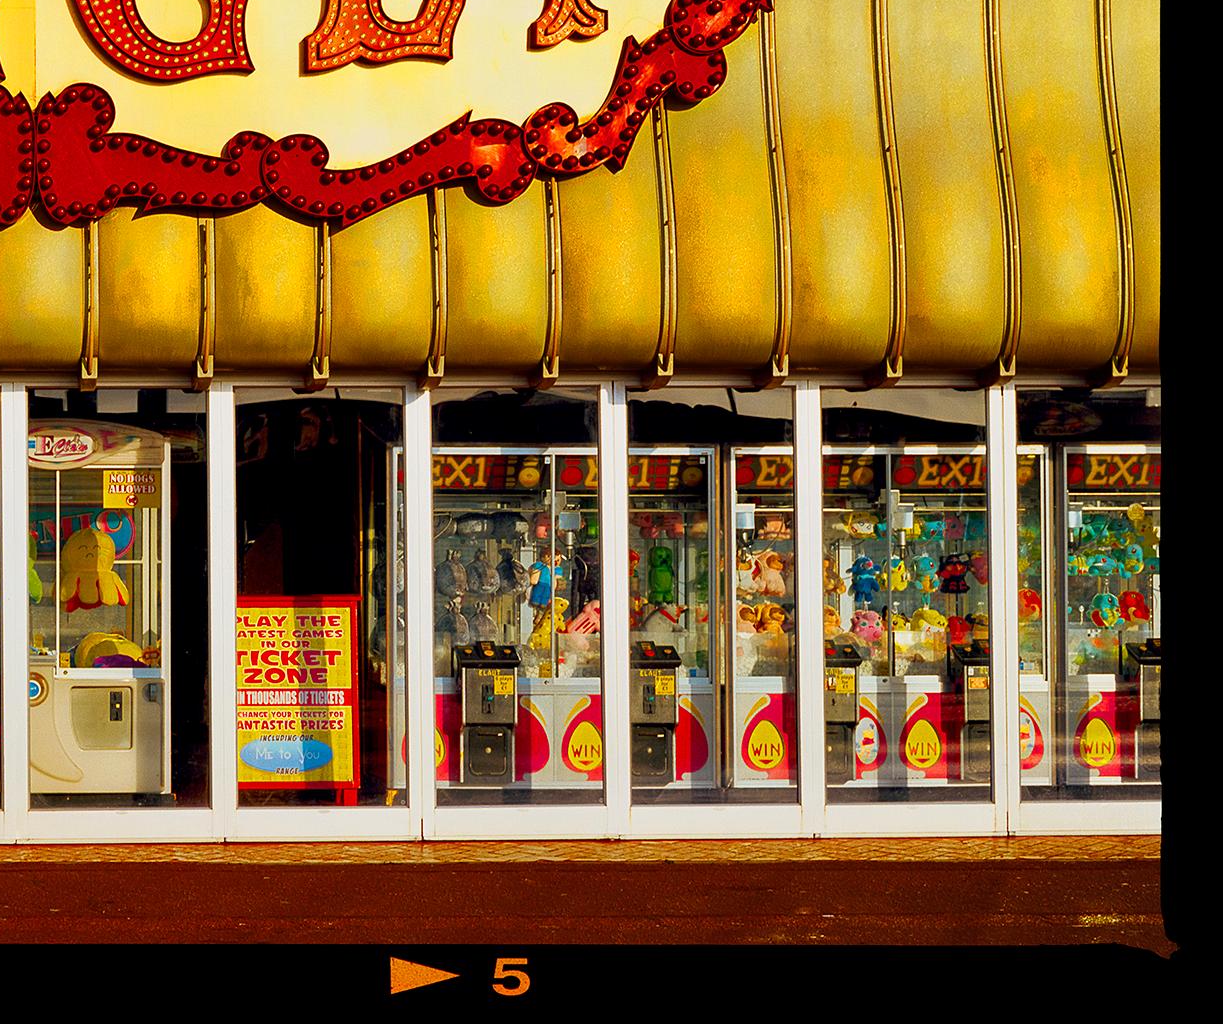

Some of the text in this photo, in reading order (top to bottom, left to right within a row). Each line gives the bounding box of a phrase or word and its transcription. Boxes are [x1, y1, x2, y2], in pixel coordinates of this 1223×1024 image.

[109, 473, 155, 483] NO DOGS
[108, 484, 156, 494] ALLOWED
[295, 615, 341, 627] THE
[237, 629, 343, 638] ATEST GAMES
[261, 640, 310, 648] IN OUR
[236, 650, 342, 666] TICKET
[243, 667, 328, 684] ZONE
[237, 690, 345, 705] IN THOUSANDS OF TICKETS
[237, 719, 344, 730] ANTASTIC PRIZES
[571, 744, 601, 758] WIN
[752, 743, 781, 757] WIN
[908, 742, 937, 756] WIN
[1082, 741, 1112, 755] WIN
[275, 767, 299, 775] RANGE
